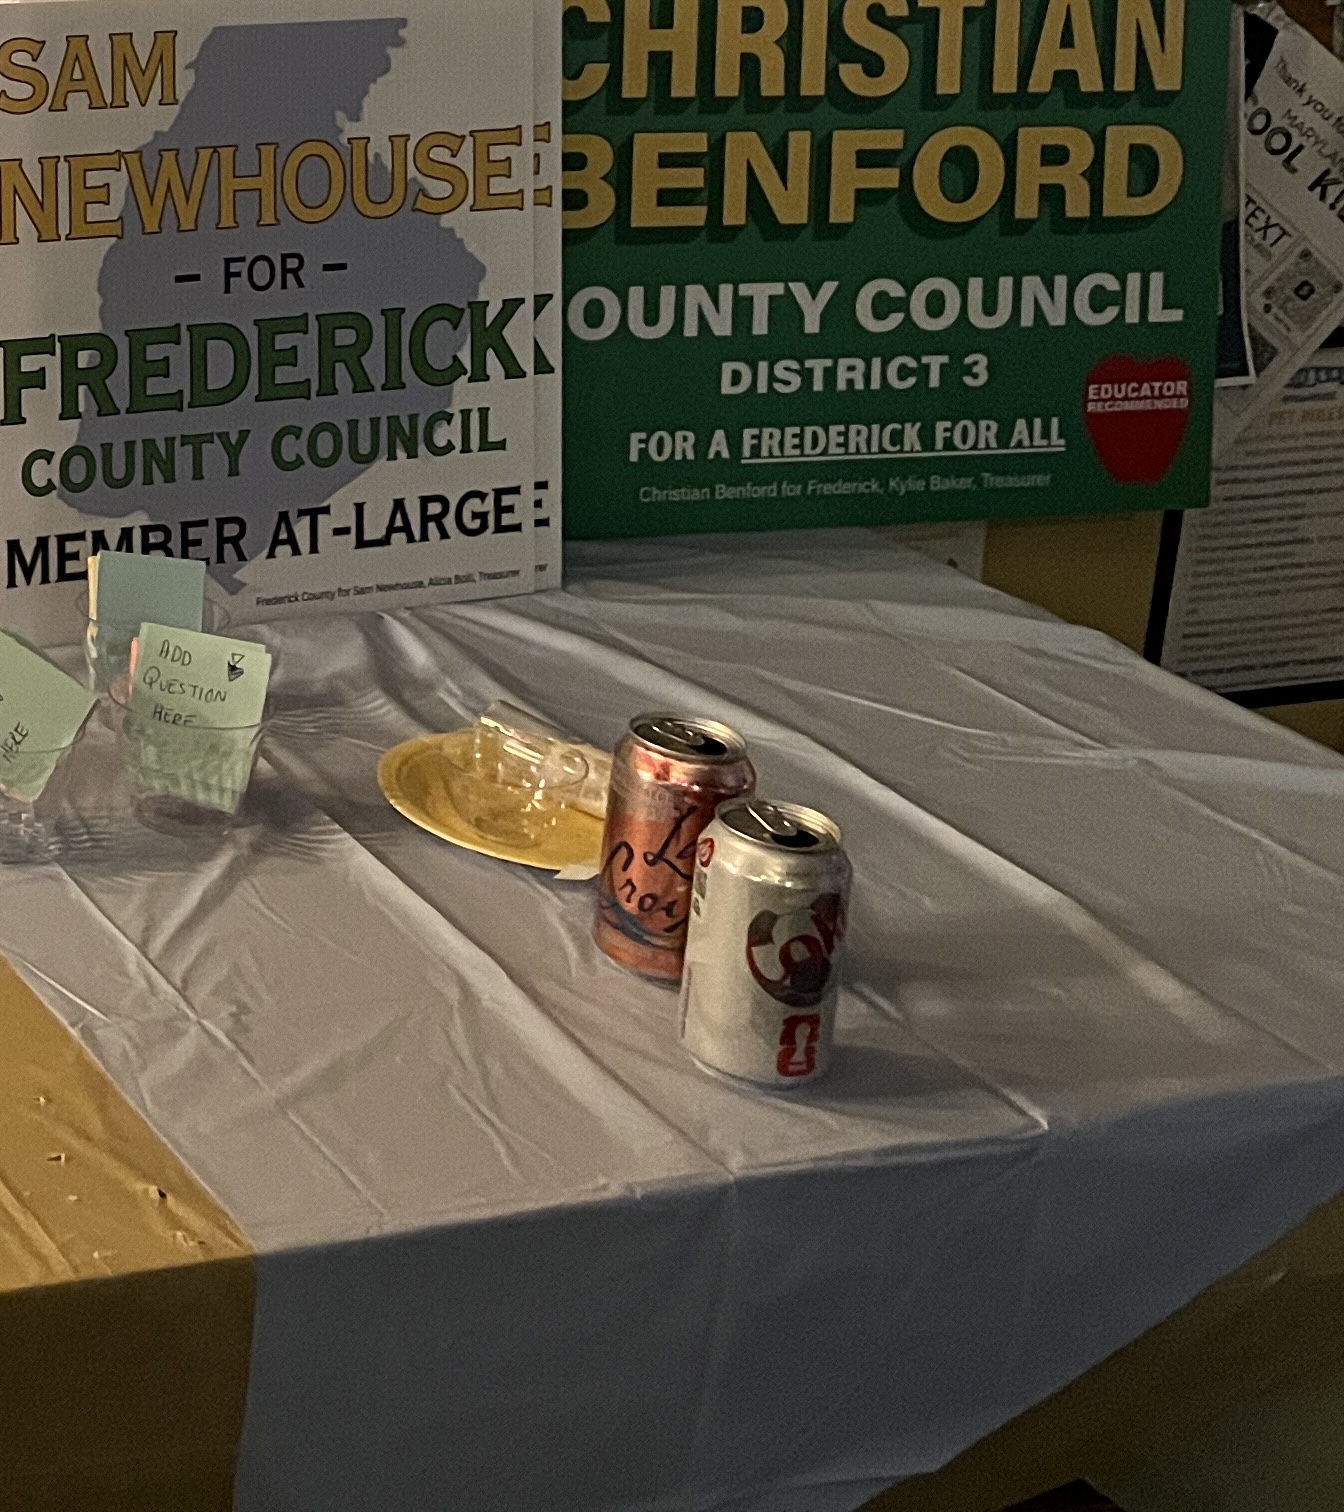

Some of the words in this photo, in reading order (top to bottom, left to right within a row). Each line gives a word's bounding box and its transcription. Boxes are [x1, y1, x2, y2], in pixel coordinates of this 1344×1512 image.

[1274, 55, 1307, 98] Thank
[1302, 94, 1335, 121] you
[563, 124, 1185, 231] BENFORD
[1245, 193, 1292, 248] TEXT
[222, 252, 305, 295] FOR
[566, 281, 840, 343] OUNTY
[854, 271, 1184, 332] COUNCIL
[0, 298, 525, 428] FREDERICK
[720, 355, 951, 396] DISTRICT
[962, 353, 990, 389] 3
[1088, 380, 1188, 400] EDUCATOR
[20, 427, 244, 498] COUNTY
[271, 406, 506, 472] COUNCIL
[629, 431, 695, 463] FOR
[707, 429, 730, 460] A
[742, 423, 922, 458] FREDERICK
[935, 419, 999, 451] FOR
[1011, 417, 1066, 449] ALL
[639, 486, 710, 502] Christian
[715, 482, 777, 500] Benford
[781, 481, 803, 496] for
[807, 478, 885, 496] Frederick,
[888, 476, 926, 496] Kylie
[930, 474, 977, 492] Baker,
[981, 473, 1052, 488] Treasurer
[4, 514, 246, 591] MEMBER
[266, 484, 517, 564] AT-LARGE
[160, 639, 192, 667] ADD
[142, 665, 227, 704] QUESTION
[152, 702, 198, 726] HERE
[0, 721, 30, 763] HERE
